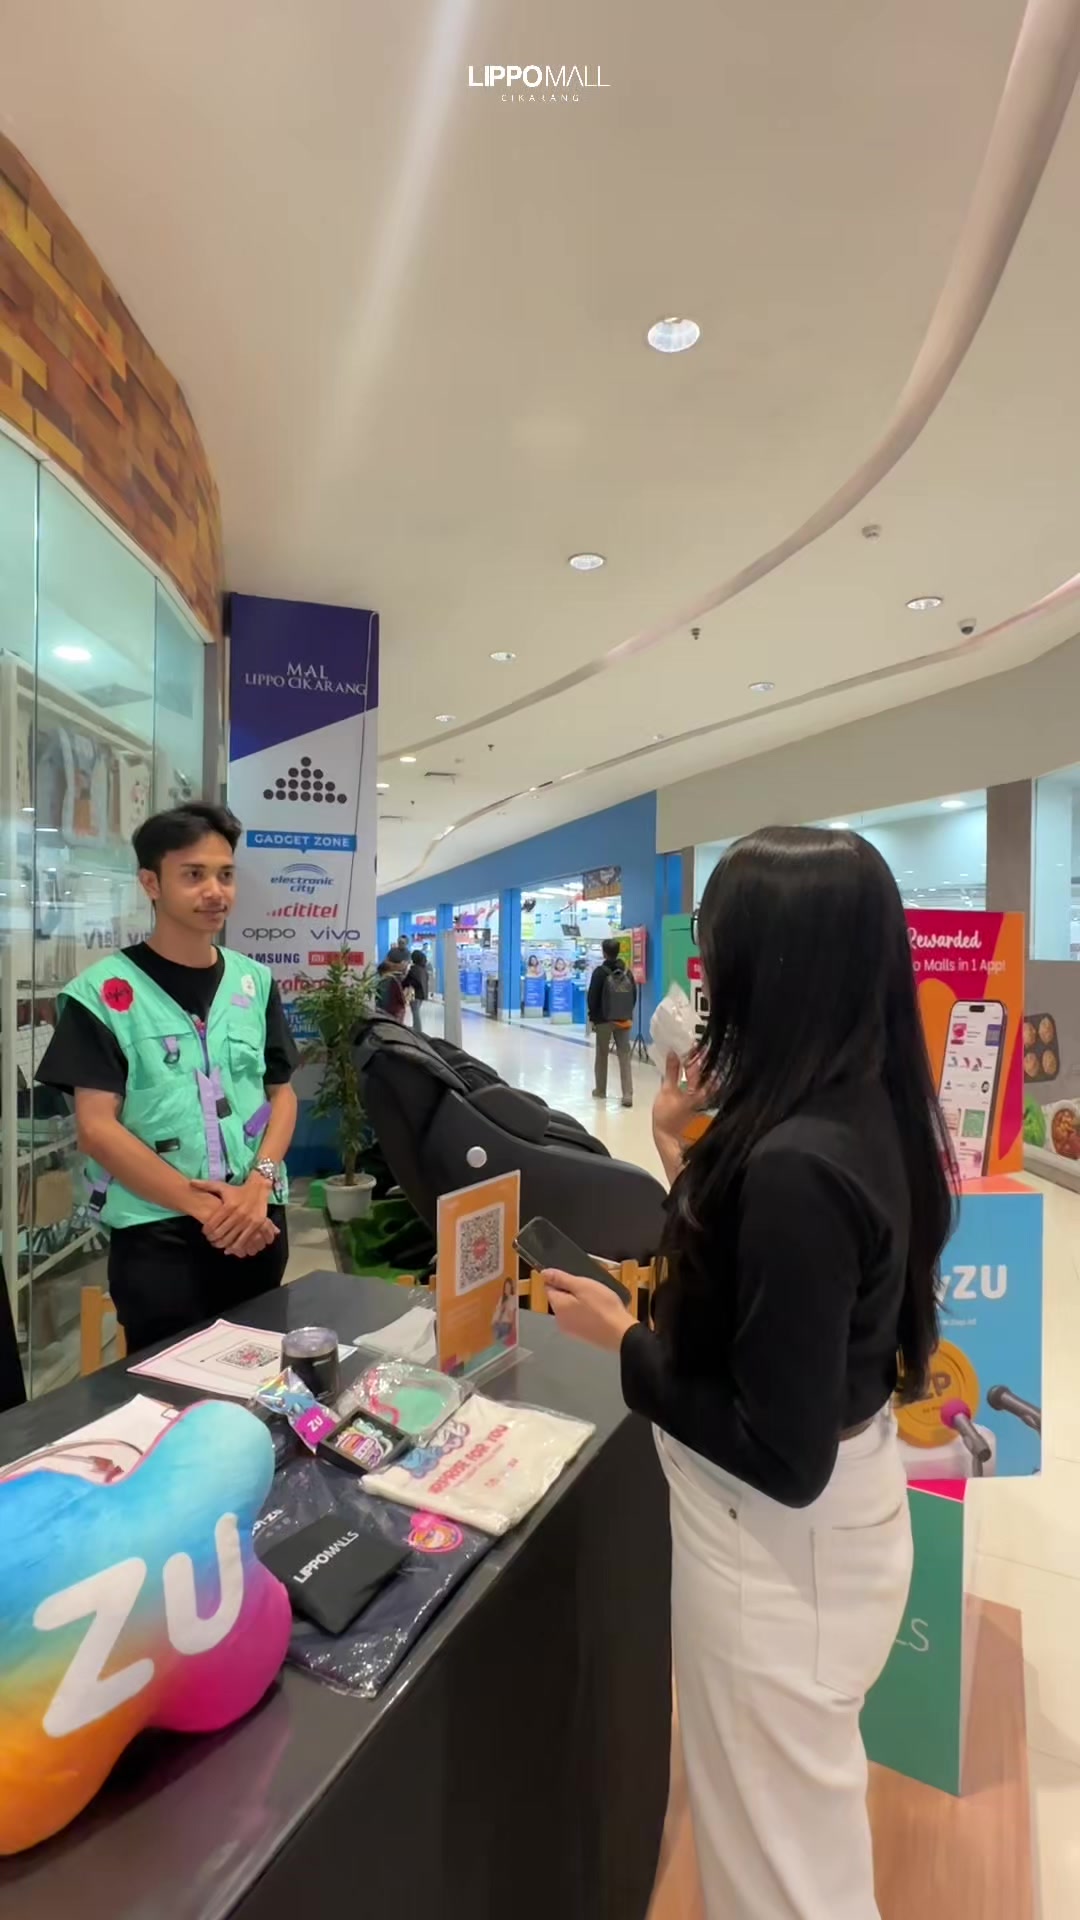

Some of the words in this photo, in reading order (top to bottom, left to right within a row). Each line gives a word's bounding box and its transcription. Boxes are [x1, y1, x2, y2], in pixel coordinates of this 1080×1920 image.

[286, 661, 329, 680] MAL
[245, 672, 285, 688] LIPPO
[287, 676, 367, 696] CIKARANG
[254, 833, 309, 846] GADGET
[313, 834, 350, 848] ZONE
[270, 874, 334, 886] electronic
[289, 884, 316, 895] city
[282, 902, 339, 919] cititel
[242, 927, 296, 941] oppo
[310, 926, 361, 941] vivo
[906, 926, 982, 950] Rewarded
[923, 959, 955, 972] Malls
[958, 957, 969, 972] in
[971, 958, 977, 972] 1
[980, 959, 1006, 976] App!
[307, 1415, 324, 1432] ZU
[33, 1511, 244, 1738] ZU
